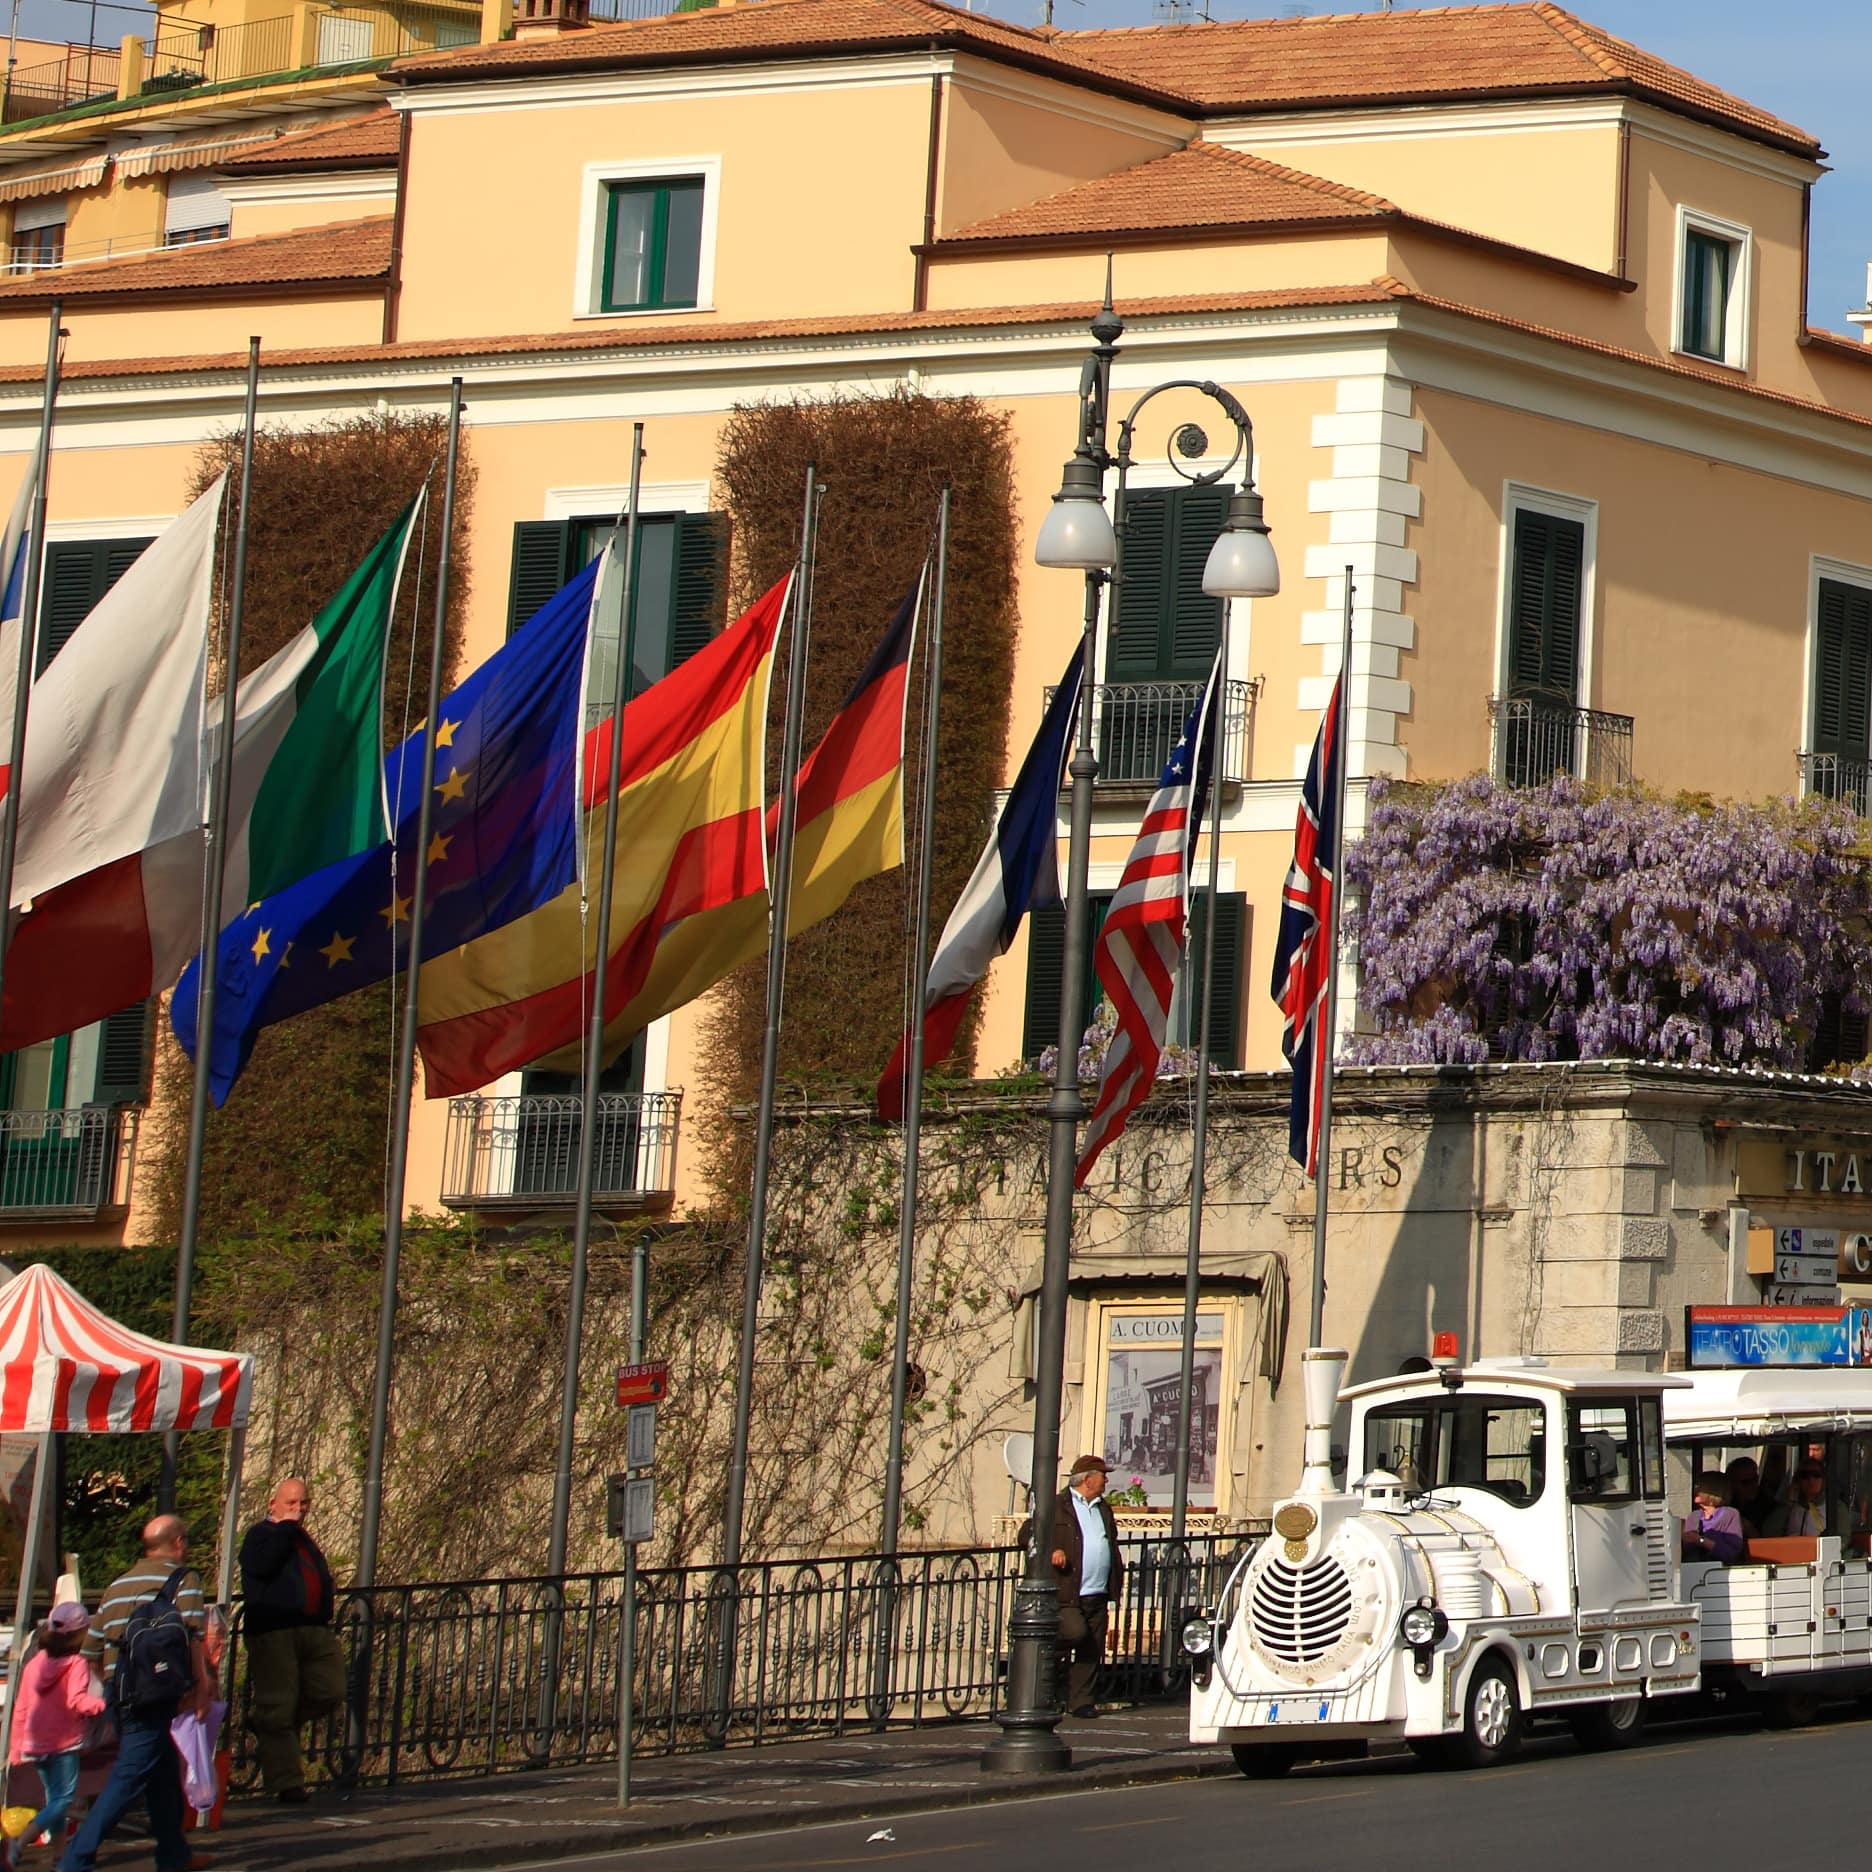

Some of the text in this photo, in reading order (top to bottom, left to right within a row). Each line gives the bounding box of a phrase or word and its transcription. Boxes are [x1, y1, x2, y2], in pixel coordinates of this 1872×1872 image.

[1112, 1319, 1199, 1337] A. CUOM
[1742, 1328, 1790, 1355] TASSO
[618, 1362, 668, 1379] BUS STOP
